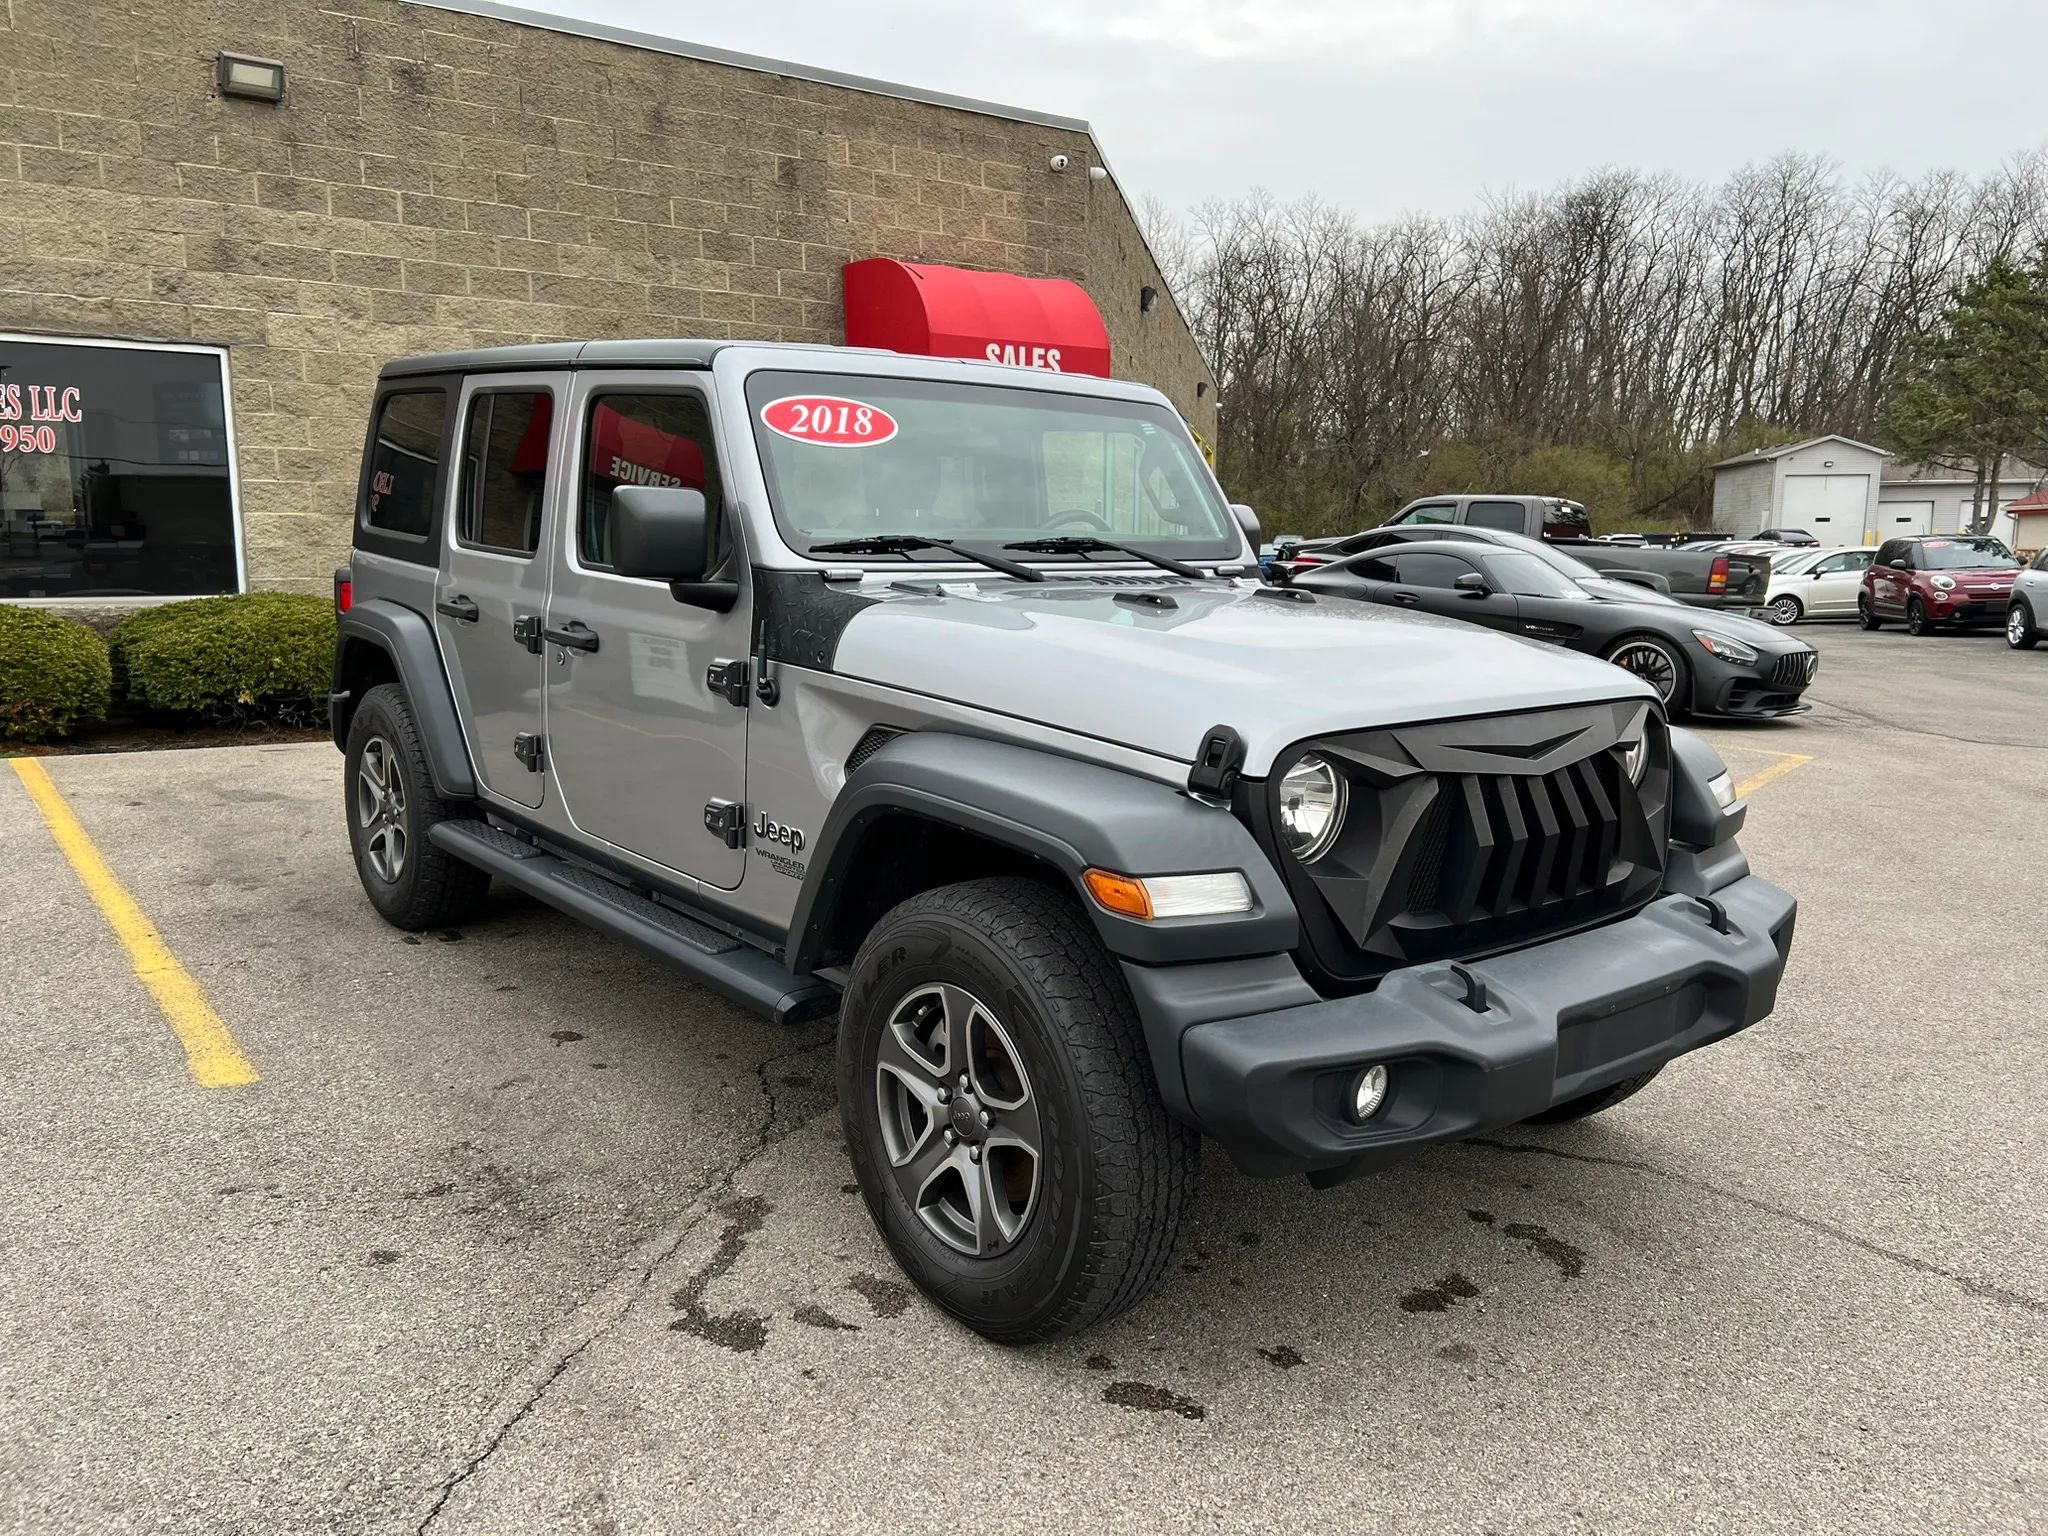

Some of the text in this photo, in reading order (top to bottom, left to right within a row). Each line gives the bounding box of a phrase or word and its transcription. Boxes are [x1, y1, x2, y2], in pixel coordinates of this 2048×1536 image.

[985, 343, 1061, 373] SALES
[28, 386, 82, 422] LLC
[789, 404, 873, 436] 2018
[0, 424, 56, 453] 950
[753, 810, 806, 855] Jeep
[756, 847, 805, 871] WRANGLER
